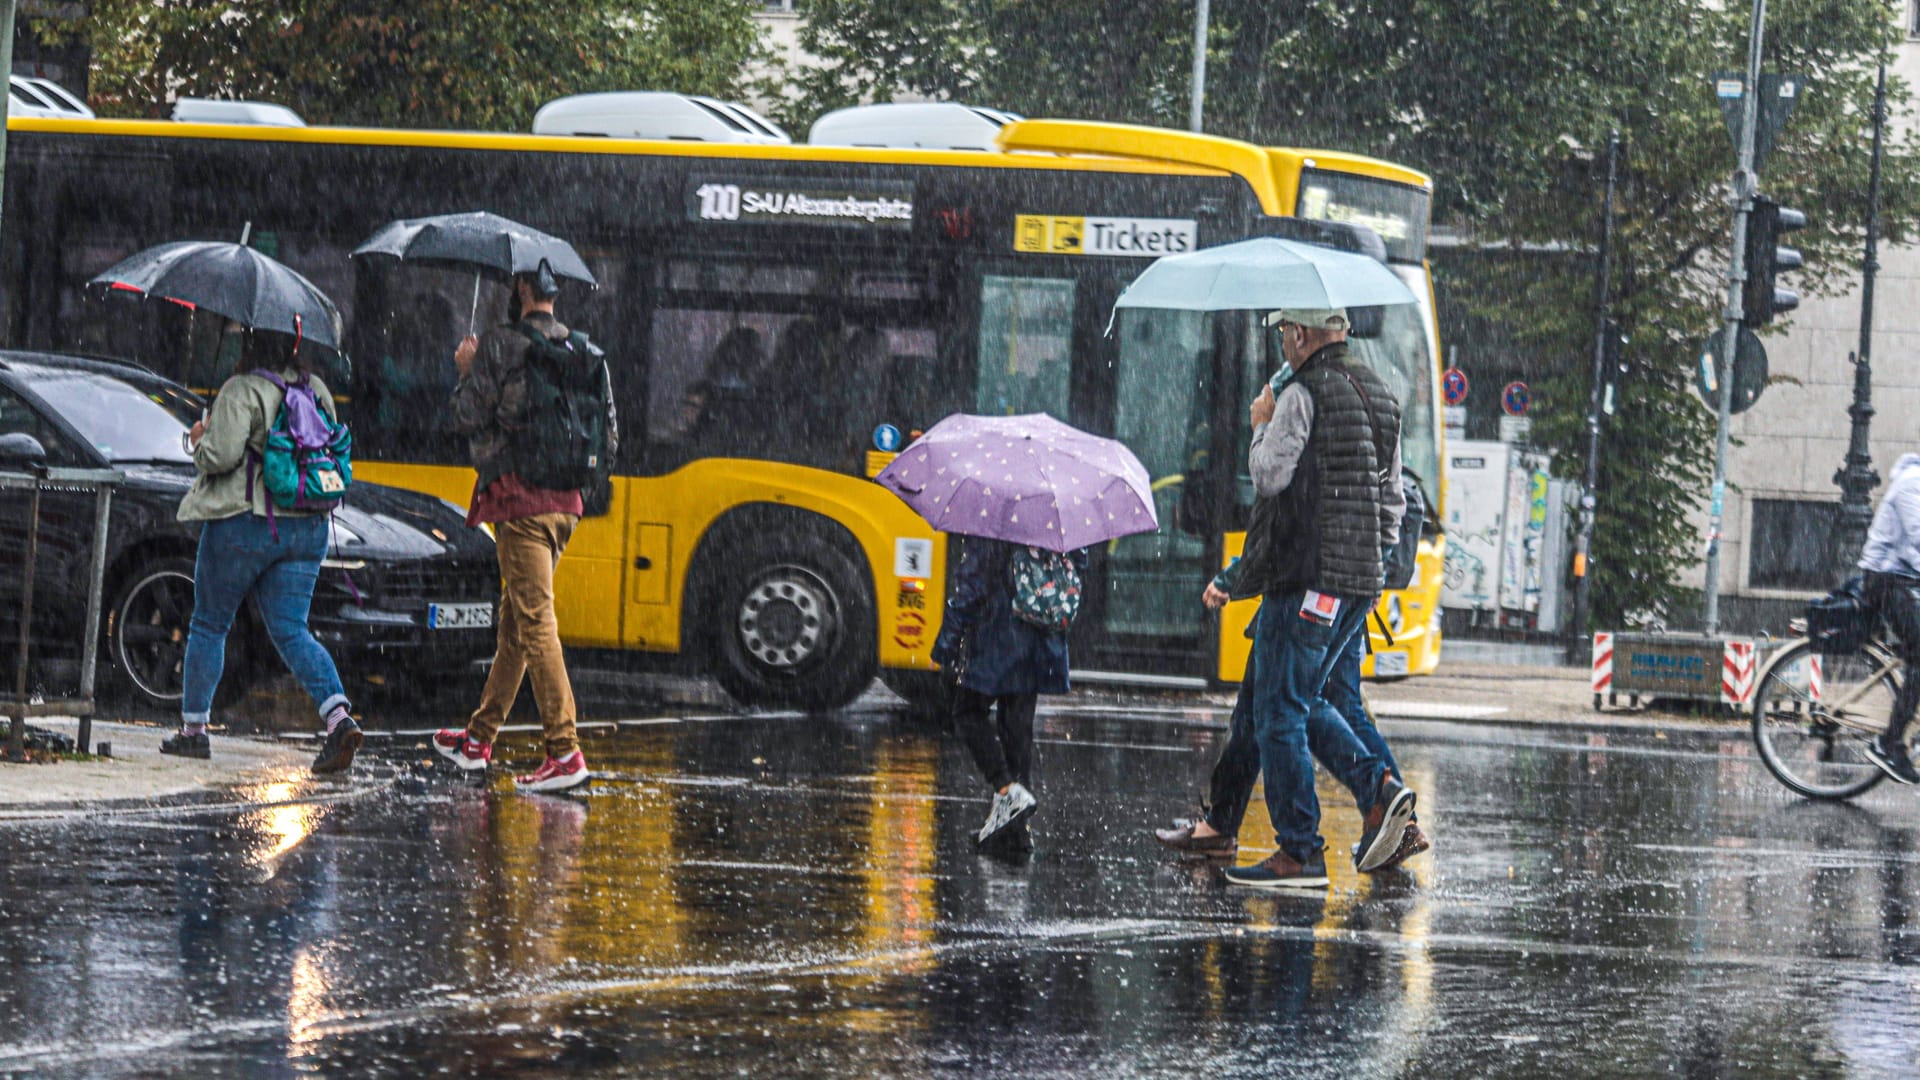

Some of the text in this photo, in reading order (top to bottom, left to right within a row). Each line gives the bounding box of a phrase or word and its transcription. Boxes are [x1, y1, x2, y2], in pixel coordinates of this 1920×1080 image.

[696, 183, 740, 220] 100
[783, 193, 912, 223] Alexanderplatz
[1092, 222, 1189, 252] Tickets
